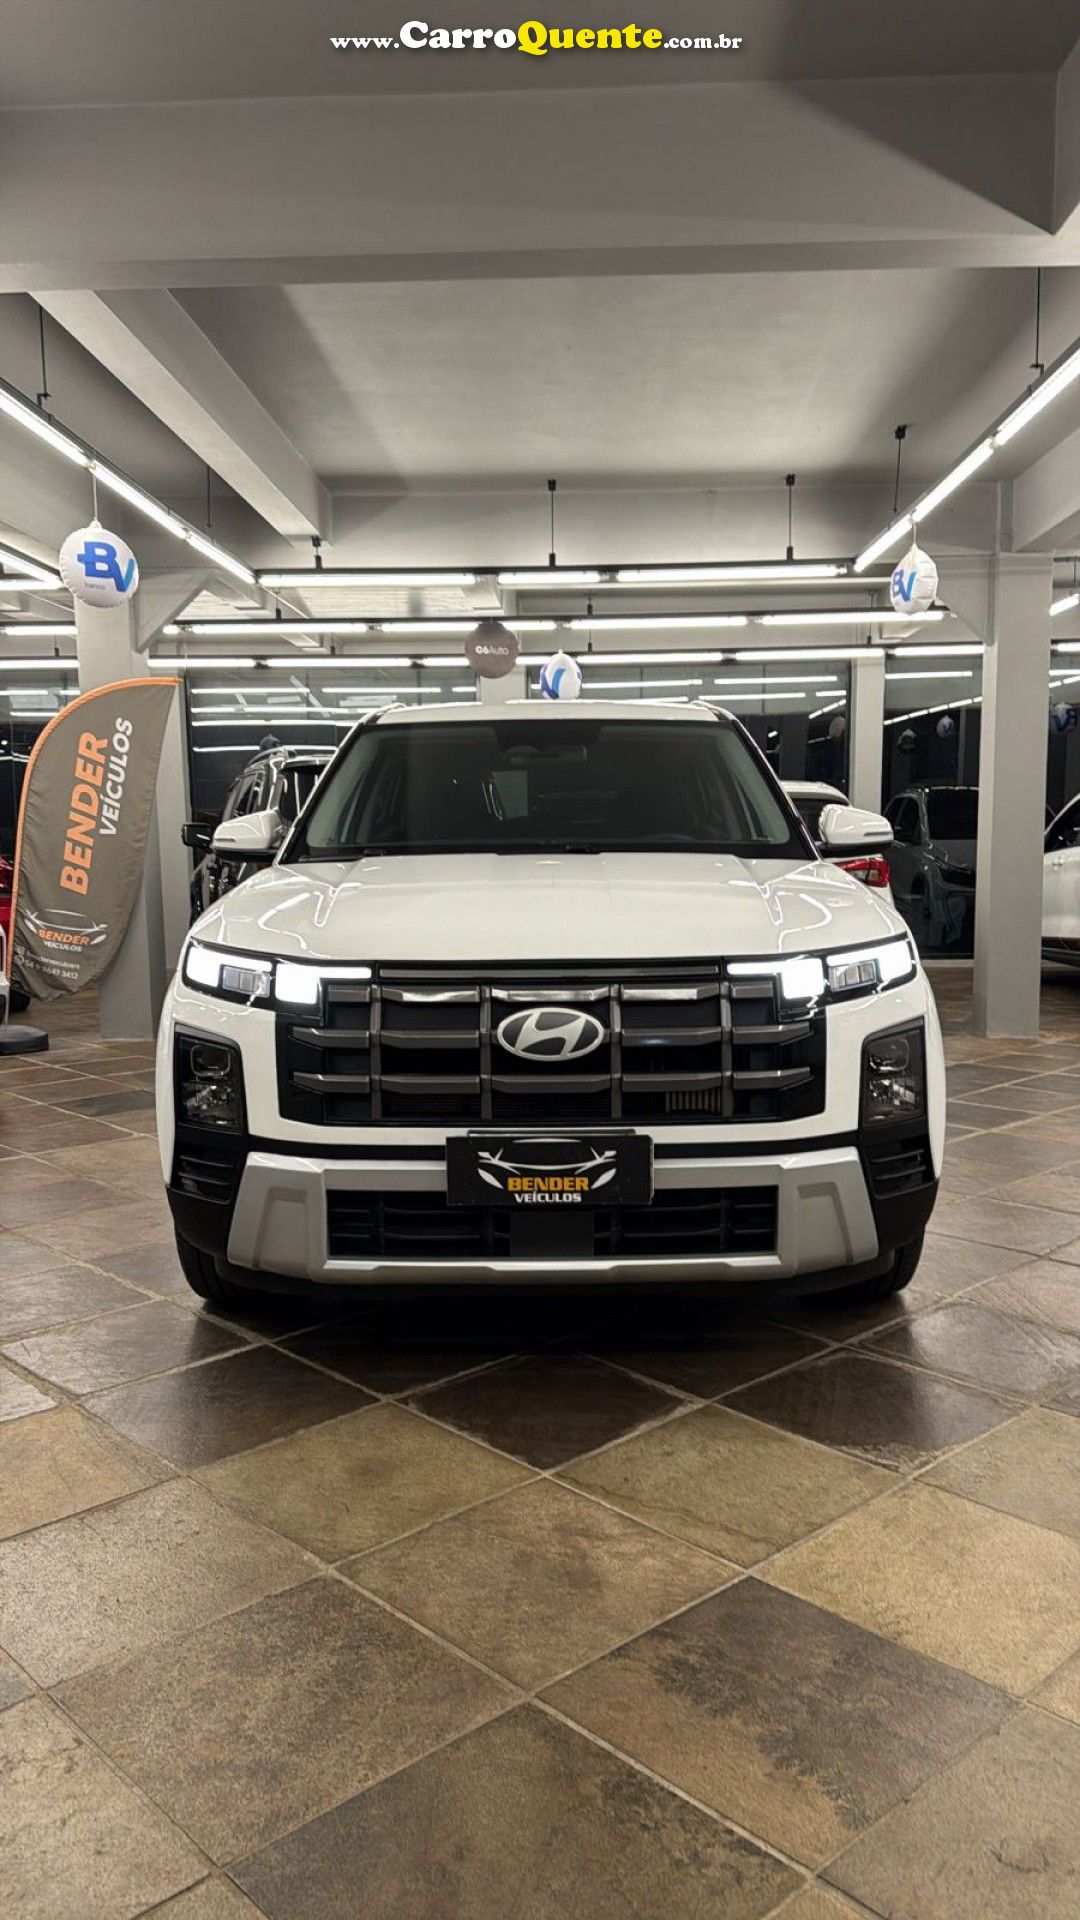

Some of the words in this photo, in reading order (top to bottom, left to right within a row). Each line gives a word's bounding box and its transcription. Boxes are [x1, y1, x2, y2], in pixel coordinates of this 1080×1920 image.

[77, 541, 135, 592] BV
[100, 717, 133, 836] VEÍCULOS
[60, 731, 108, 895] BENDER
[38, 928, 90, 946] BENDER
[507, 1176, 589, 1192] BENDER
[514, 1190, 582, 1203] VEÍCULOS
